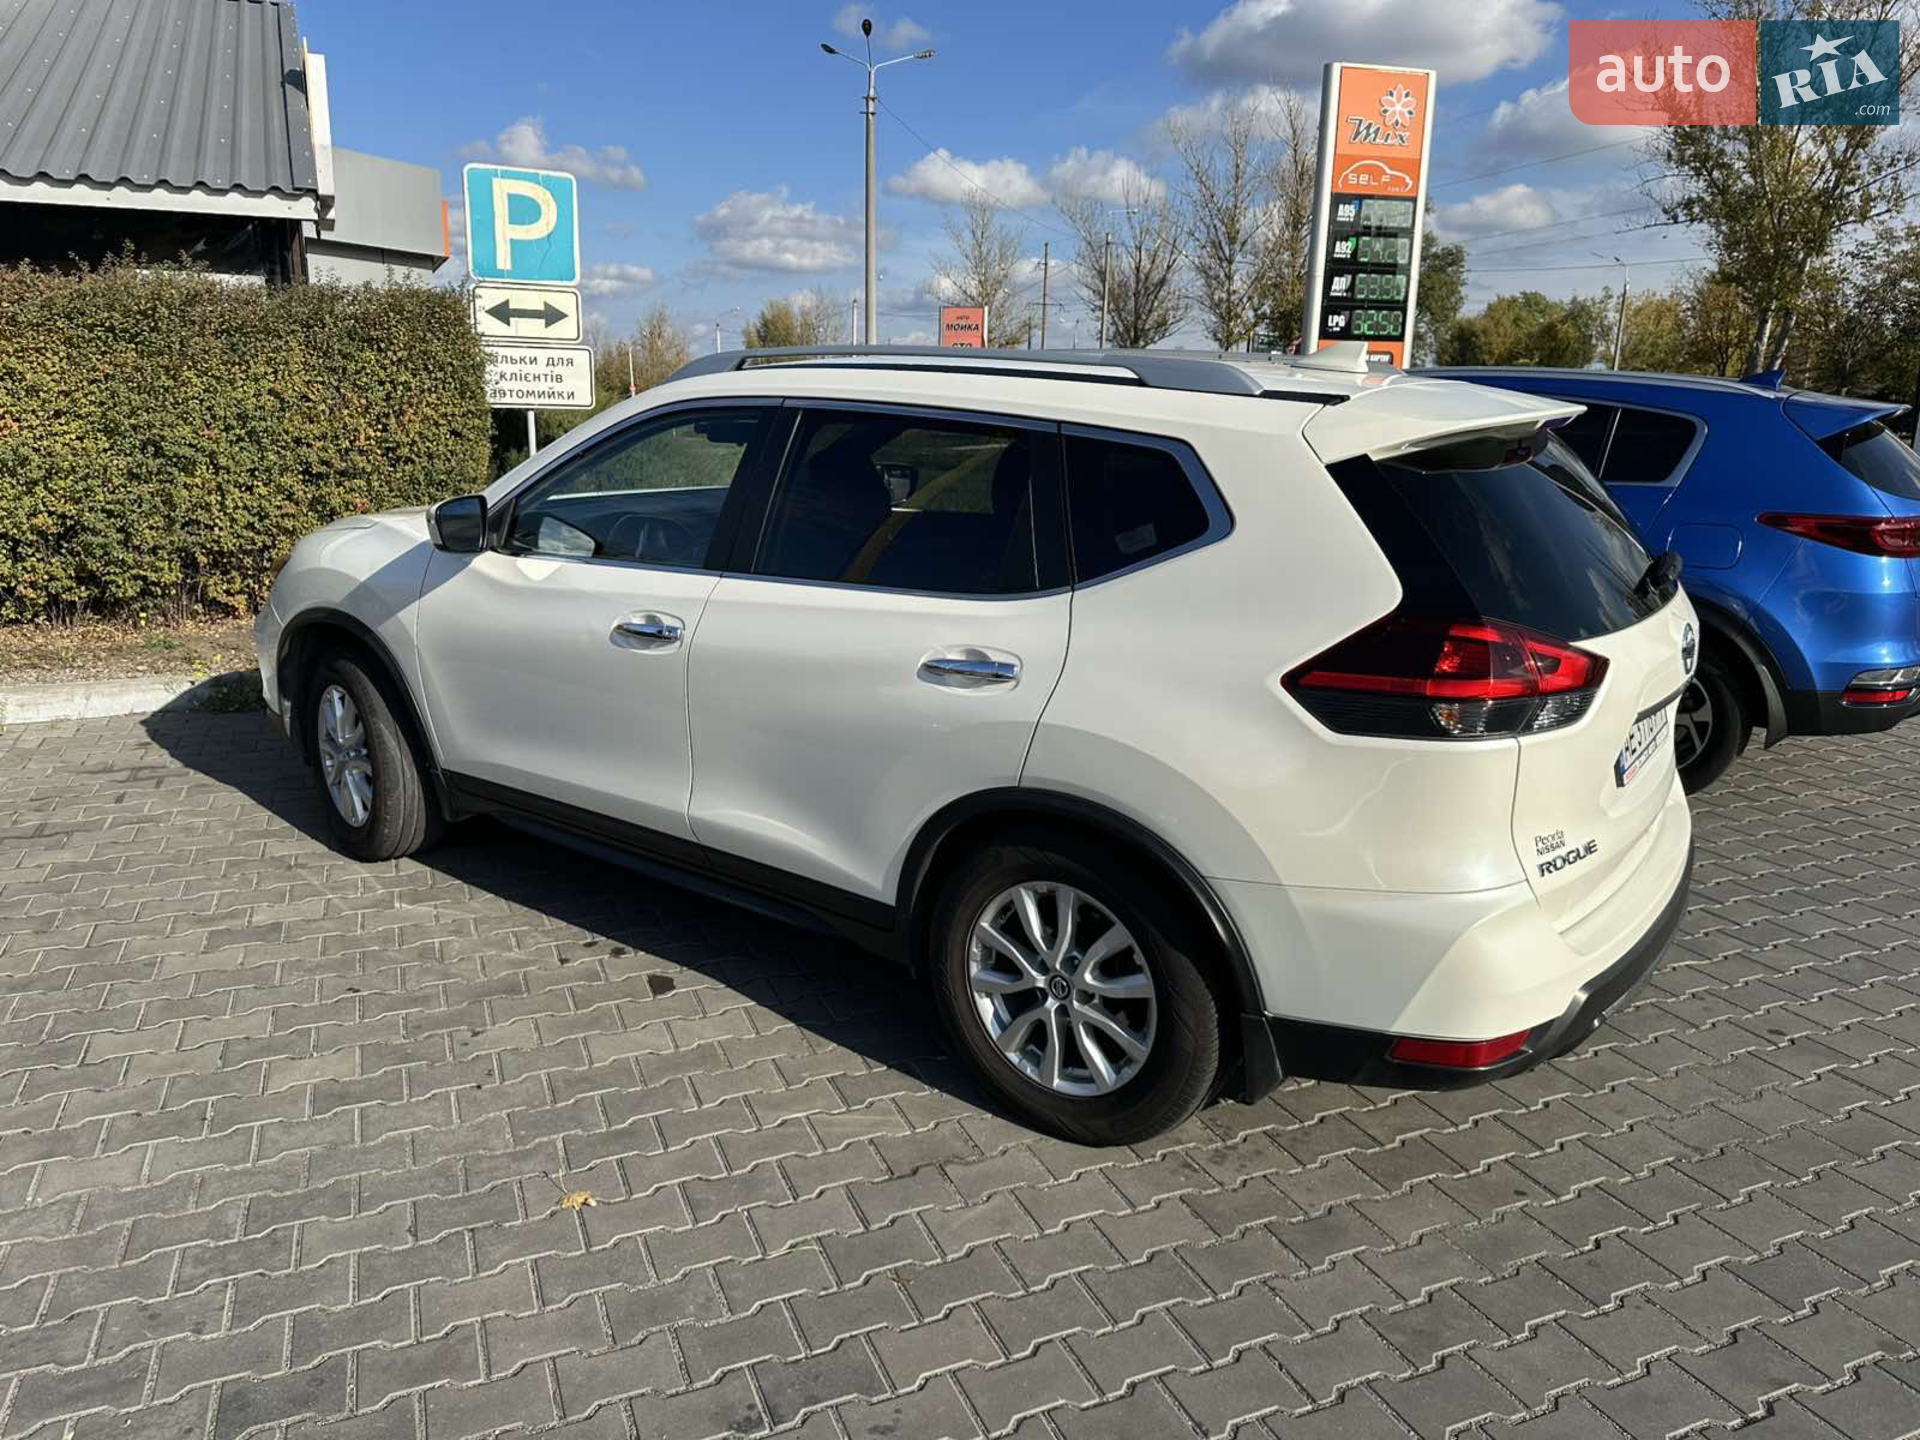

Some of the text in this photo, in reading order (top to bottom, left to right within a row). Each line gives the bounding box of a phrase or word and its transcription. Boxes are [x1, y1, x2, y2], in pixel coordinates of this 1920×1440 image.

[492, 177, 557, 270] P
[545, 356, 574, 368] для
[499, 369, 564, 384] клієнтів
[489, 386, 576, 400] автомийки
[1536, 840, 1565, 856] NISSAN
[1537, 838, 1598, 877] ROGUE
